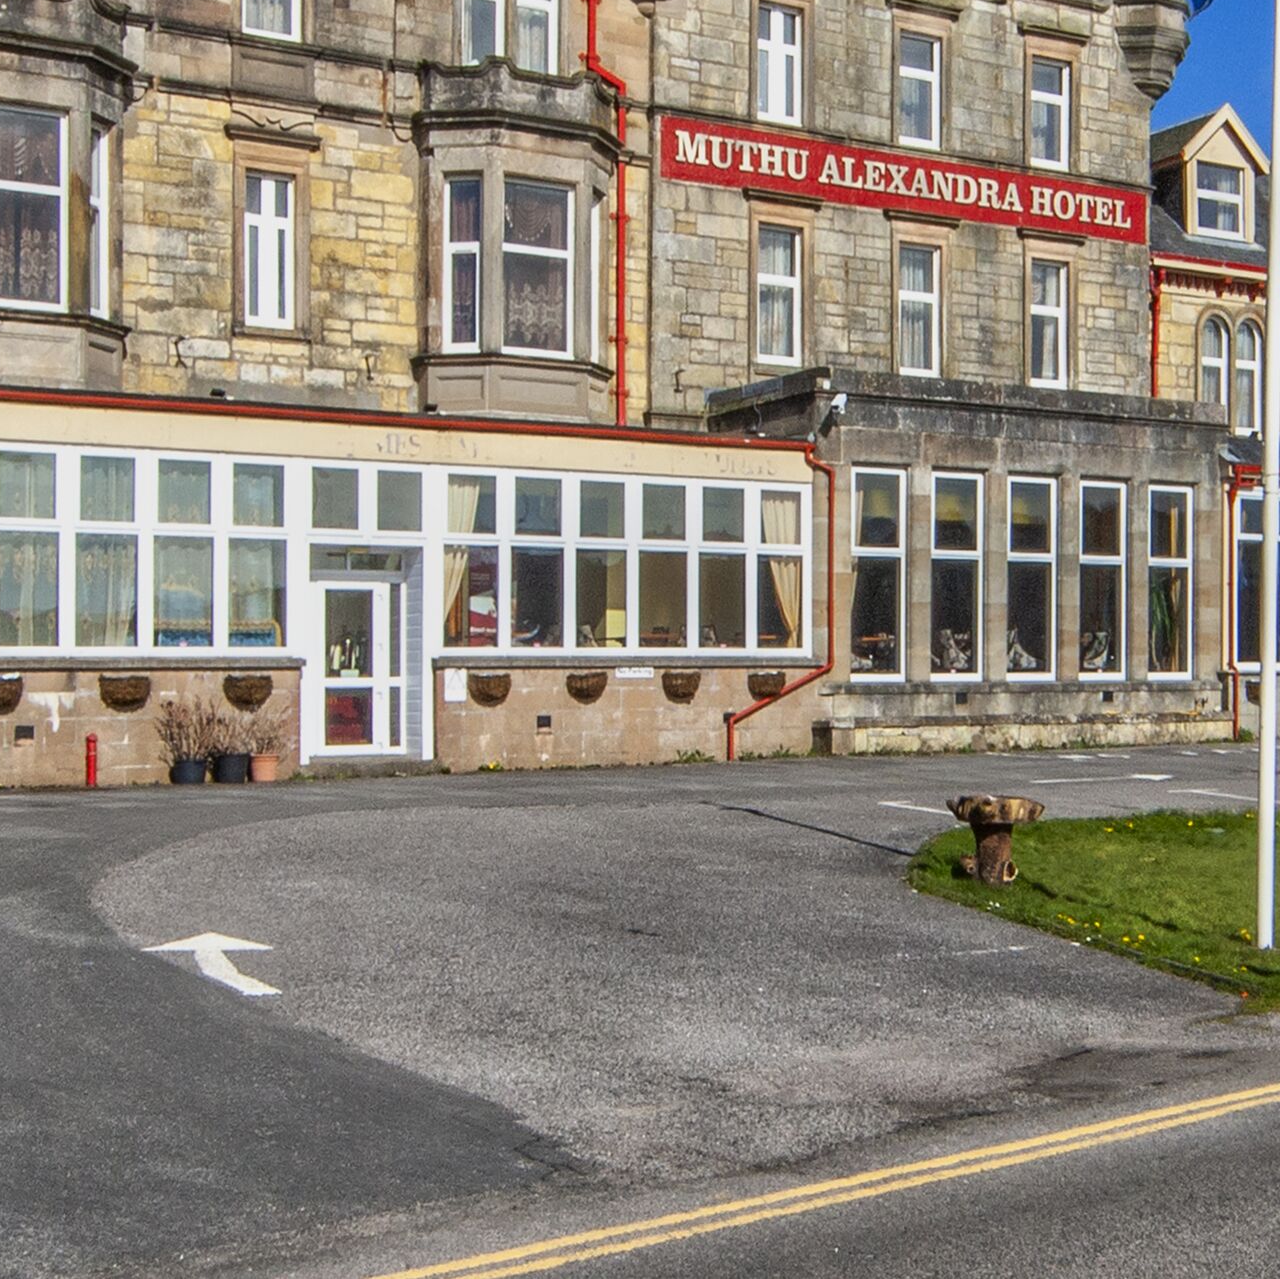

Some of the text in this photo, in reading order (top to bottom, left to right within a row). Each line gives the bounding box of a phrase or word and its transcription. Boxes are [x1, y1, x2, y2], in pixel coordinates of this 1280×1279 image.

[674, 129, 1132, 229] MUTHU ALEXANDRA HOTEL
